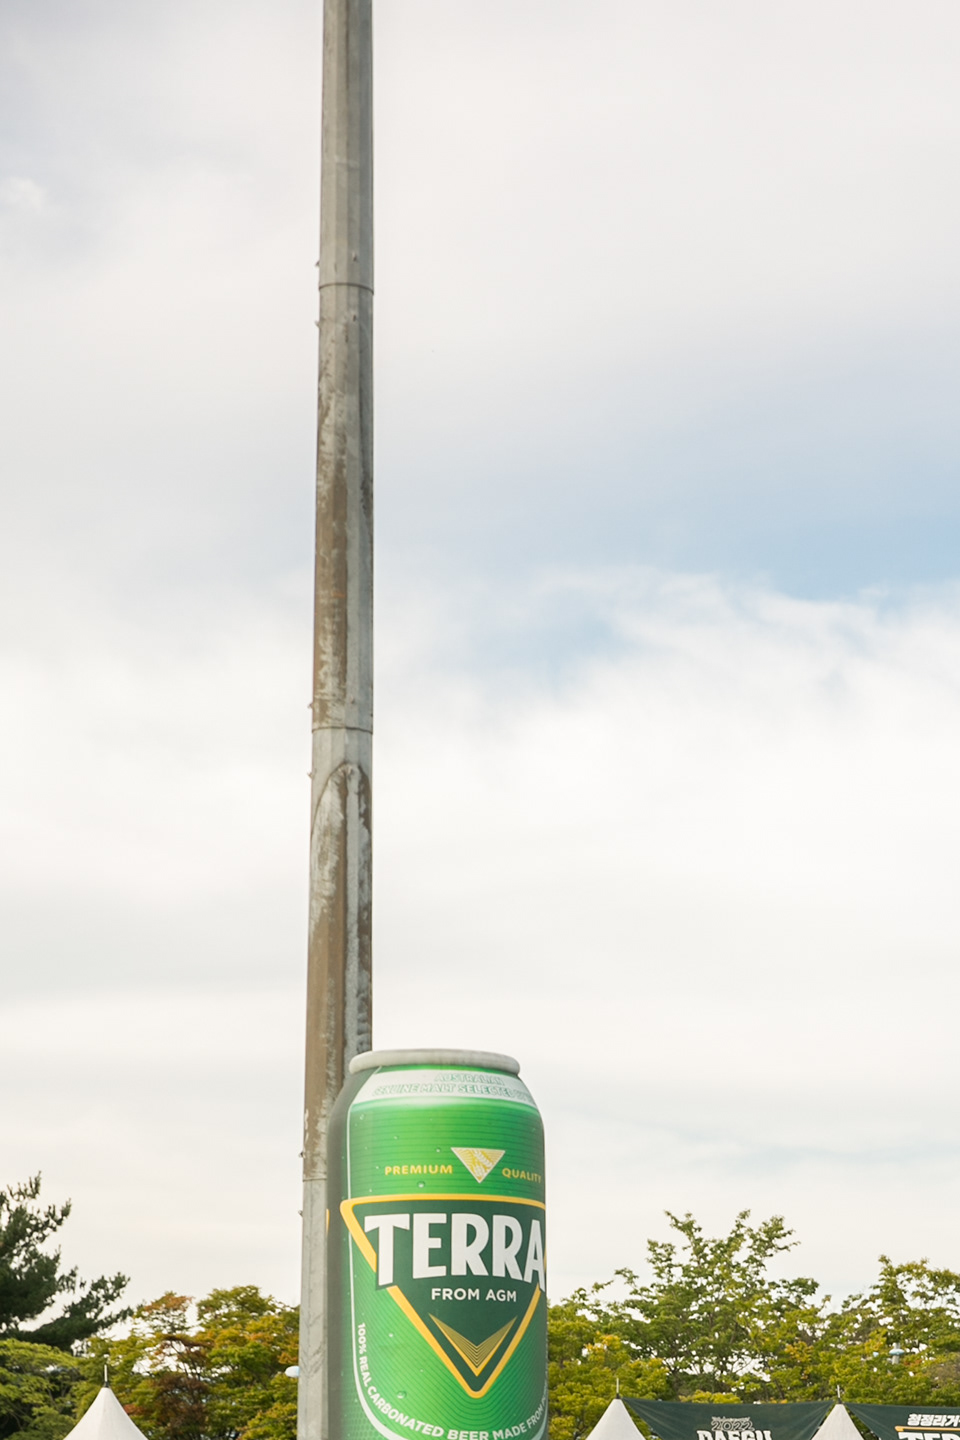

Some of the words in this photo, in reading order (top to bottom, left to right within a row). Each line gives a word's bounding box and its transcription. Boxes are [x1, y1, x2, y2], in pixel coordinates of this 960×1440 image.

[420, 1083, 457, 1093] MALT
[384, 1163, 453, 1176] PREMIUM
[501, 1167, 542, 1184] QUALITY
[364, 1213, 546, 1292] TERRA
[431, 1287, 480, 1301] FROM
[485, 1289, 517, 1302] AGM
[357, 1322, 367, 1354] 100%
[359, 1356, 373, 1389] REAL
[367, 1386, 445, 1438] CARBONATED
[492, 1424, 527, 1440] MADE
[711, 1420, 755, 1432] 2022
